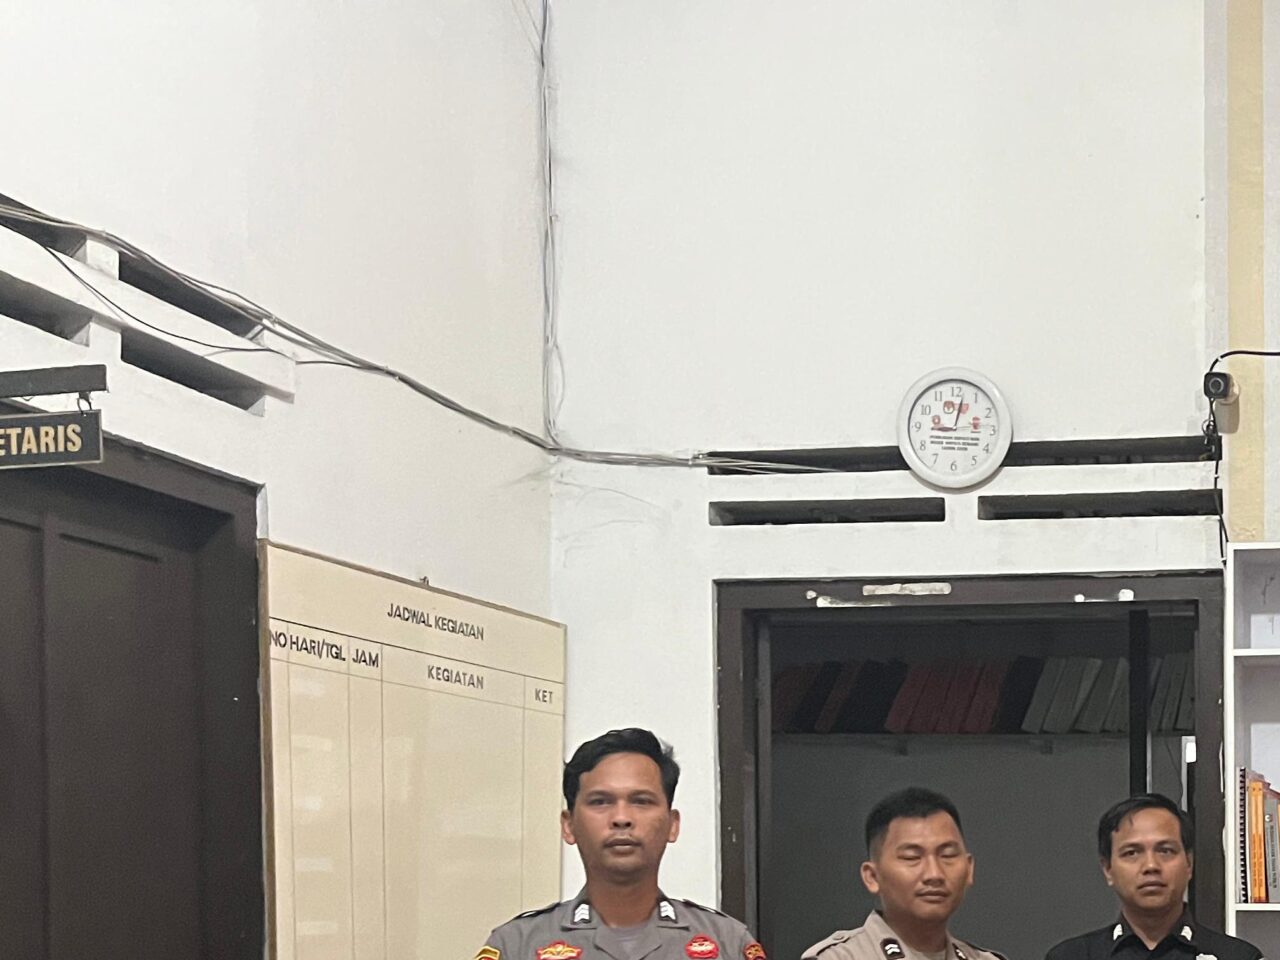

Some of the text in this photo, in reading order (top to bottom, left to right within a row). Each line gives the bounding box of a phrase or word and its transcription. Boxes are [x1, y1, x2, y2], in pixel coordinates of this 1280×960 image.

[934, 390, 943, 402] 11
[951, 386, 962, 397] 12
[920, 404, 931, 415] 10
[984, 407, 992, 418] 2
[914, 421, 922, 432] 9
[0, 424, 82, 456] ETARIS
[920, 440, 926, 451] 8
[982, 443, 990, 454] 4
[932, 453, 939, 465] 7
[971, 455, 978, 466] 5
[950, 460, 957, 471] 6
[387, 603, 484, 641] JADWAL KEGIATAN
[269, 629, 287, 648] NO
[352, 648, 379, 668] JAM
[427, 664, 484, 690] KEGIATAN
[534, 688, 554, 704] KET
